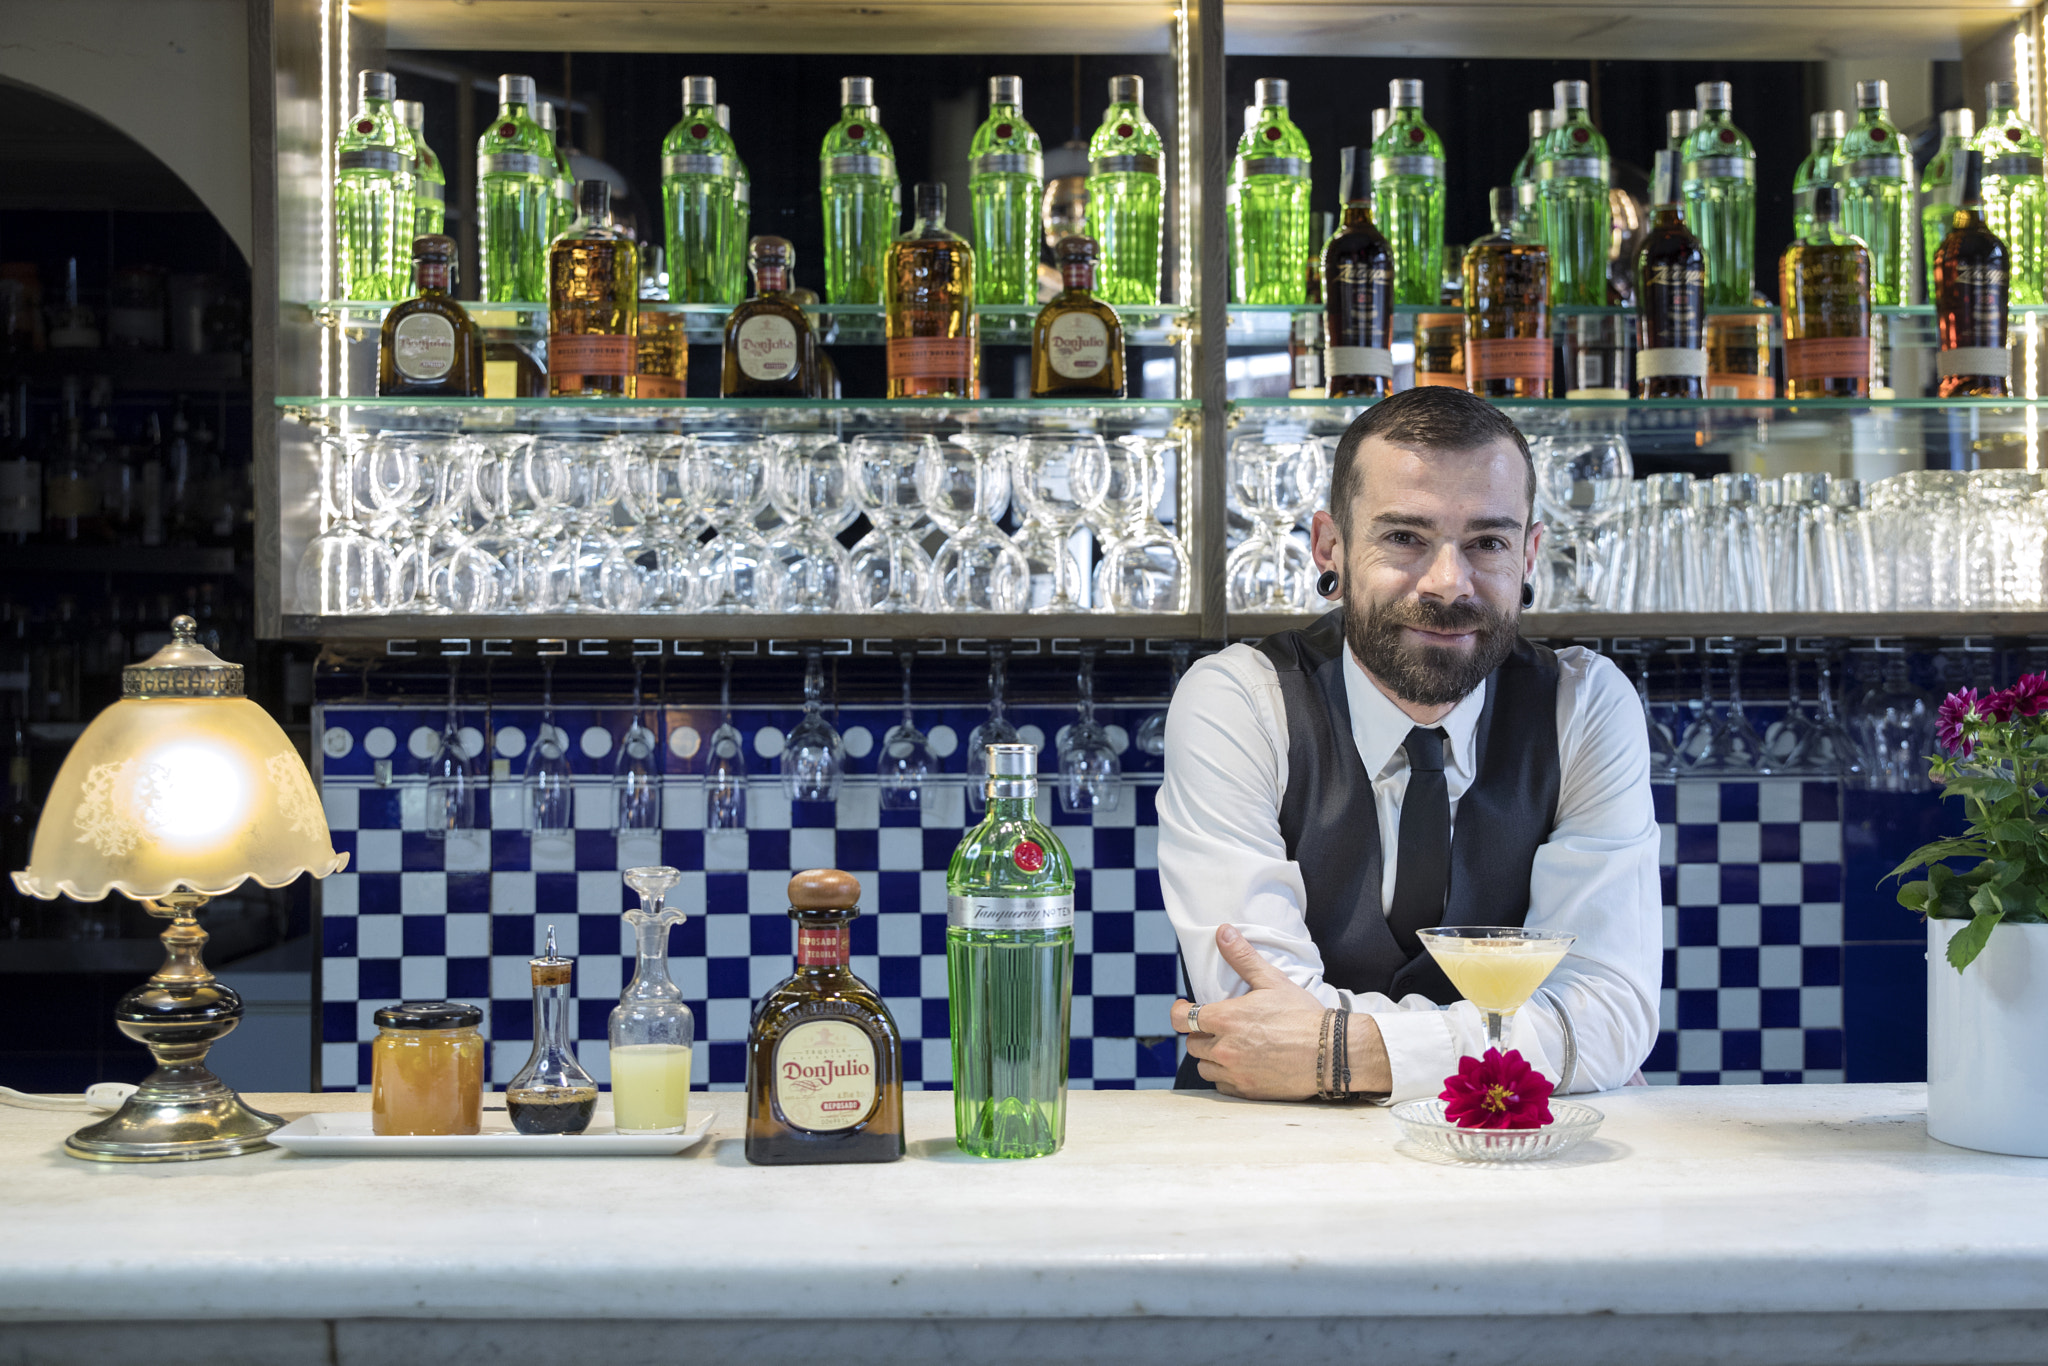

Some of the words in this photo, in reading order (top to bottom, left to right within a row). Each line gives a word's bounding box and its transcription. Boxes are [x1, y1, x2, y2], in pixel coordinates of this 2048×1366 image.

[974, 904, 1040, 922] Tanqueray
[807, 950, 837, 959] TEQUILA
[823, 1100, 858, 1111] REPOSADO
